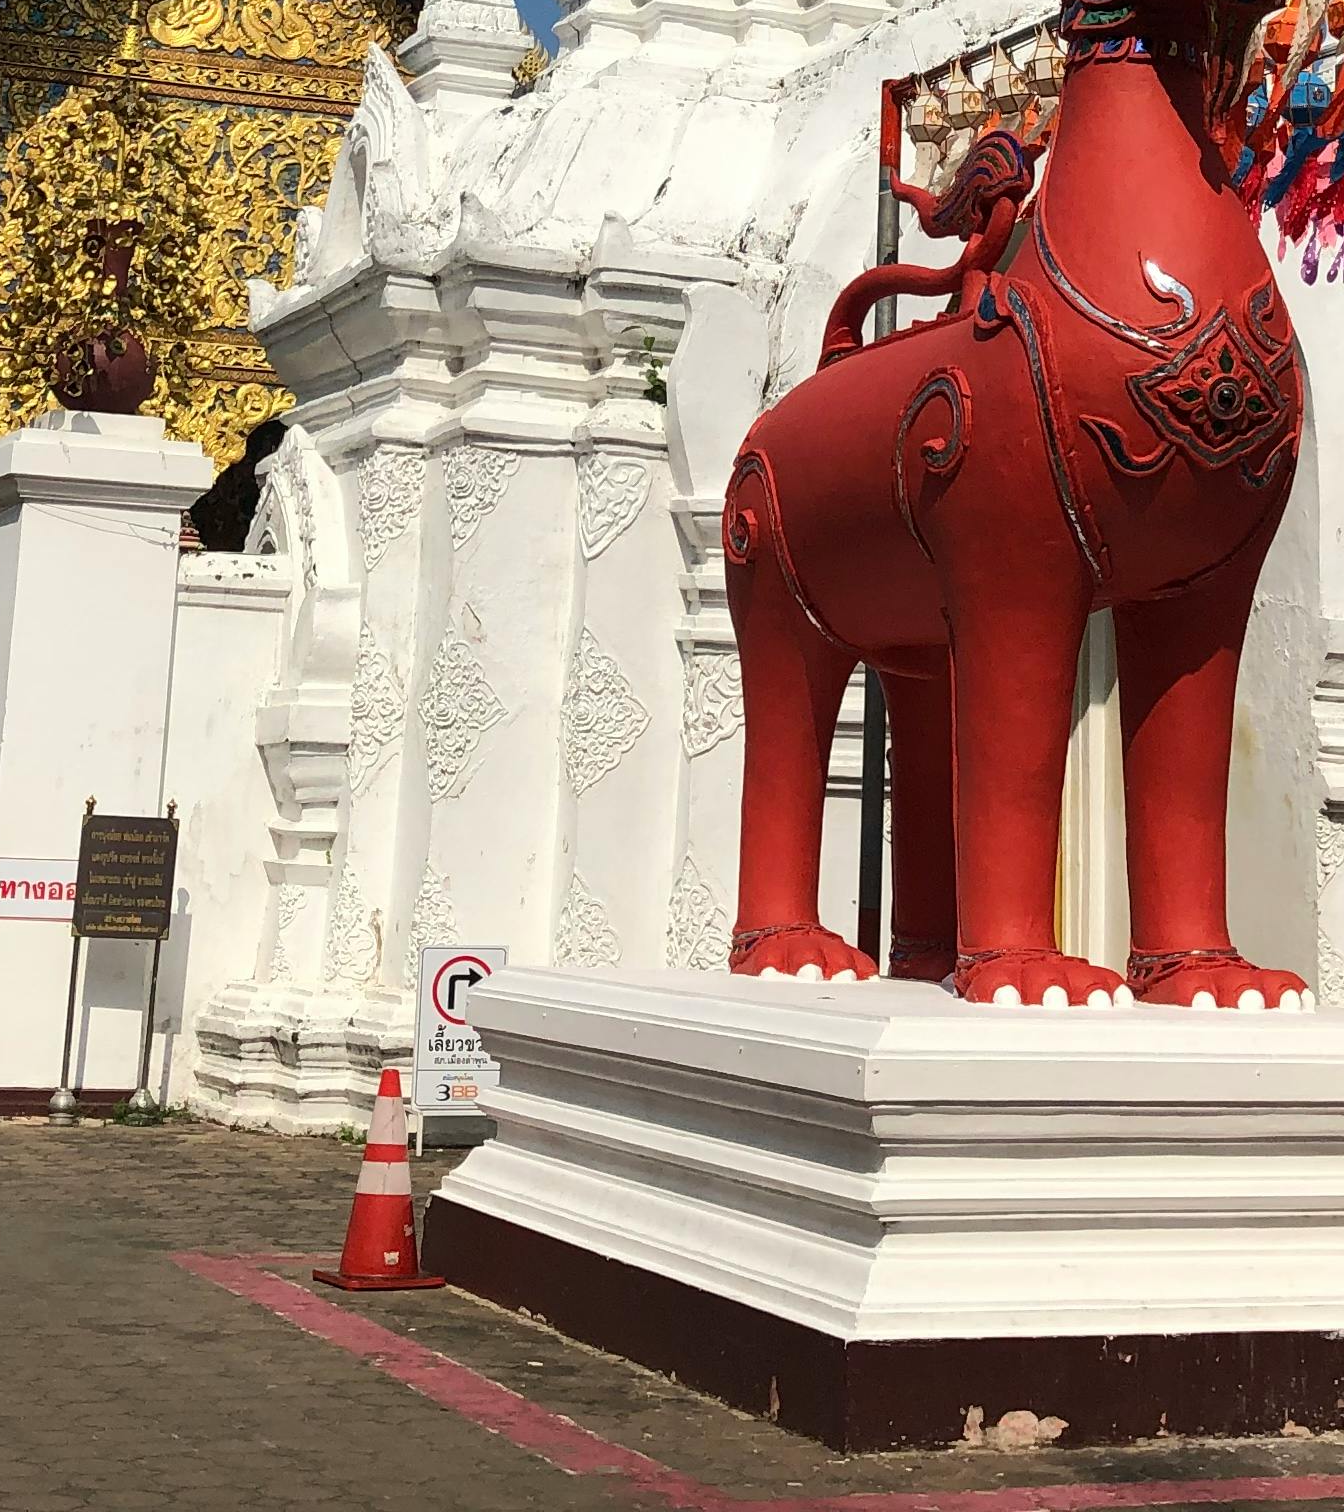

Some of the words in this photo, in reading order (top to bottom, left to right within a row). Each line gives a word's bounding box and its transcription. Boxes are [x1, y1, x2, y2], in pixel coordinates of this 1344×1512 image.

[428, 1024, 483, 1052] เลี้ยวขว
[435, 1084, 479, 1102] 3BB
